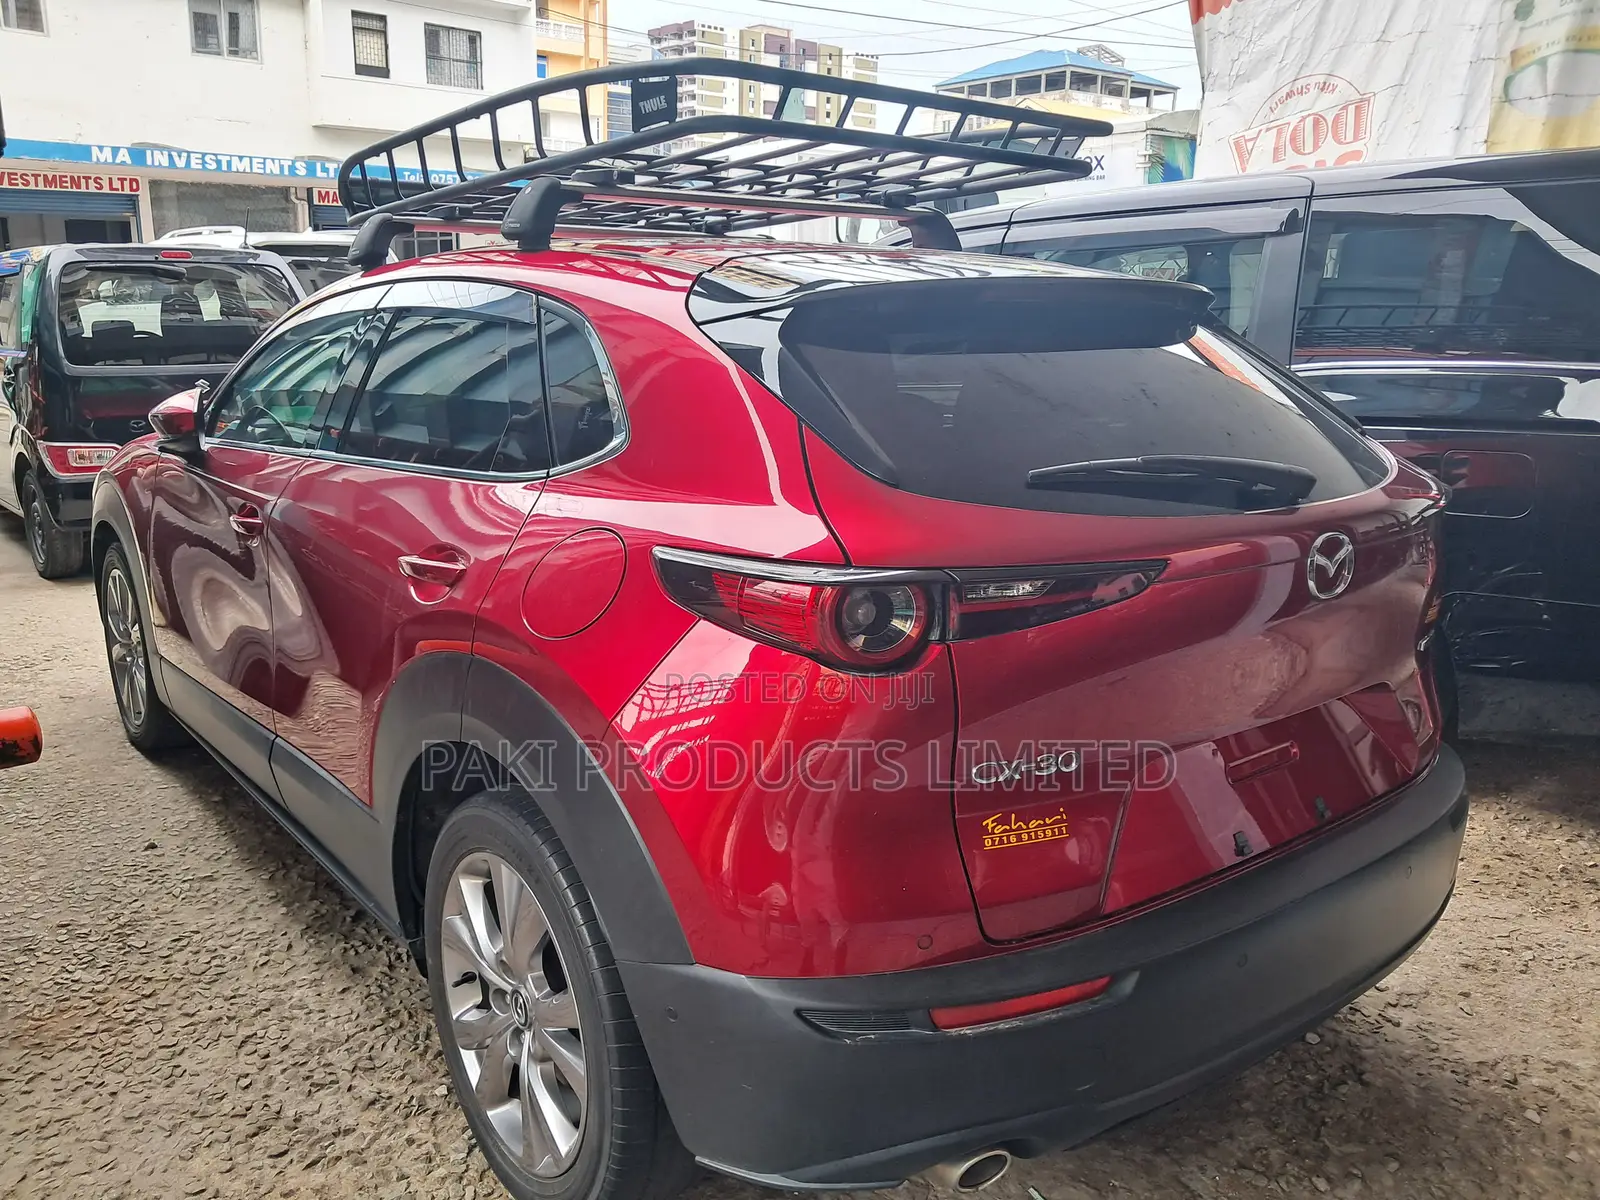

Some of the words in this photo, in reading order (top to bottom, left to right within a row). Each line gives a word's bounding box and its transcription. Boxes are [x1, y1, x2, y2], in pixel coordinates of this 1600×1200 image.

[638, 95, 668, 115] THULE
[1232, 97, 1371, 173] DOLA
[91, 146, 132, 165] MA
[146, 149, 307, 176] INVESTMENTS
[316, 161, 342, 178] LT
[108, 176, 140, 193] LTD
[317, 190, 340, 204] MA
[971, 750, 1081, 785] CX-30
[982, 807, 1067, 834] Fahari
[984, 834, 1017, 847] 0716
[1021, 826, 1067, 842] 915911
